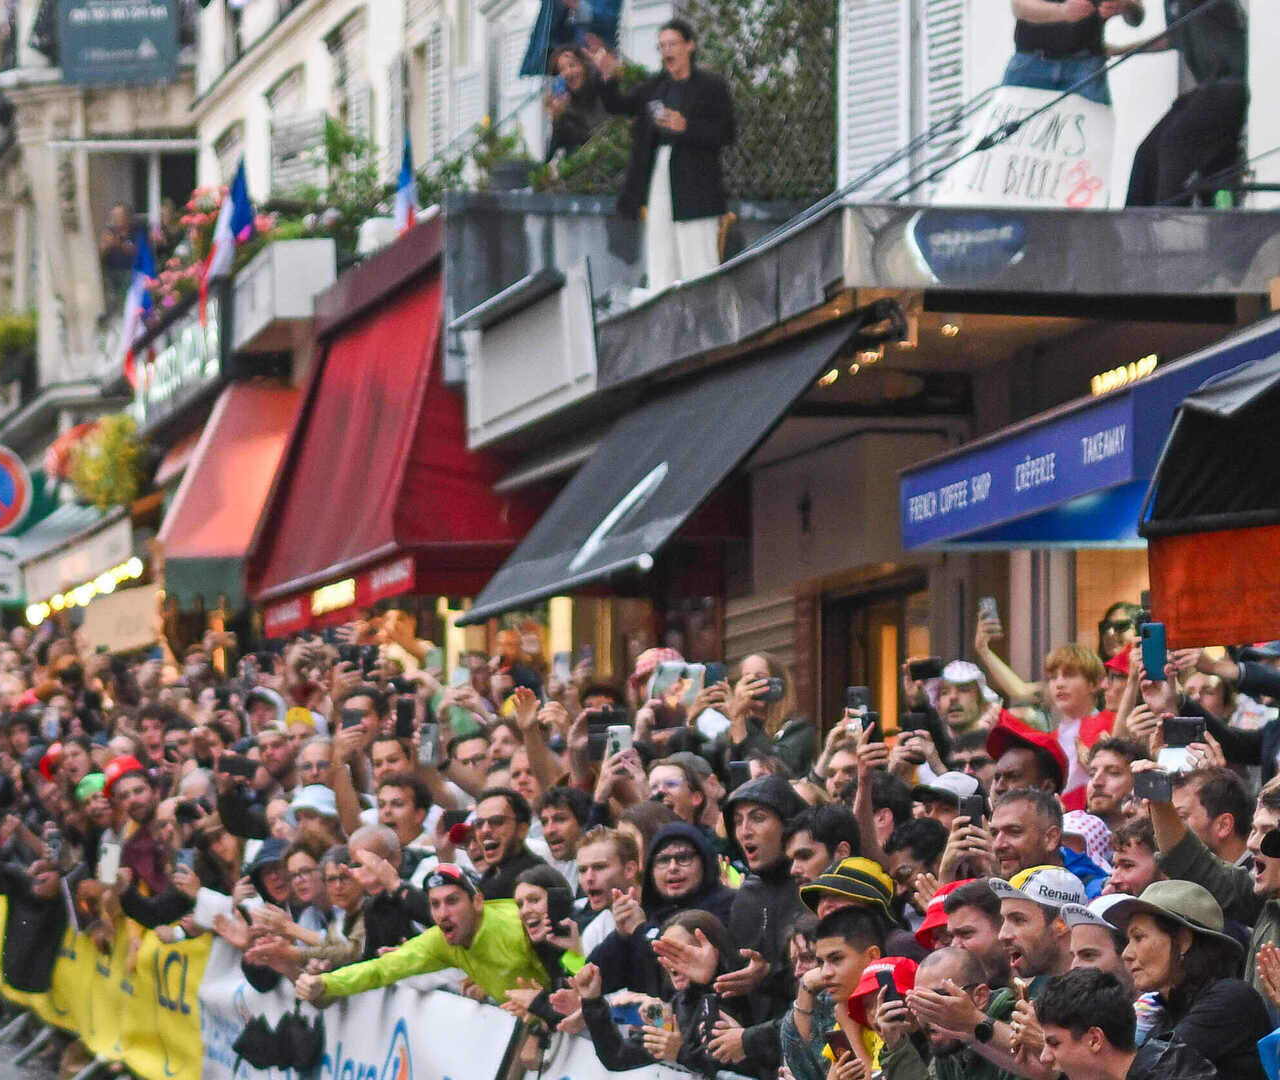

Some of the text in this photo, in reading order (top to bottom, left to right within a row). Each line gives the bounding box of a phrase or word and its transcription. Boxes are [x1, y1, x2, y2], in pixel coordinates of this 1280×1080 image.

[1081, 424, 1126, 465] TAKEAWAY
[909, 472, 992, 524] FRENCH COFFEE SHOP
[1039, 885, 1080, 903] Renault
